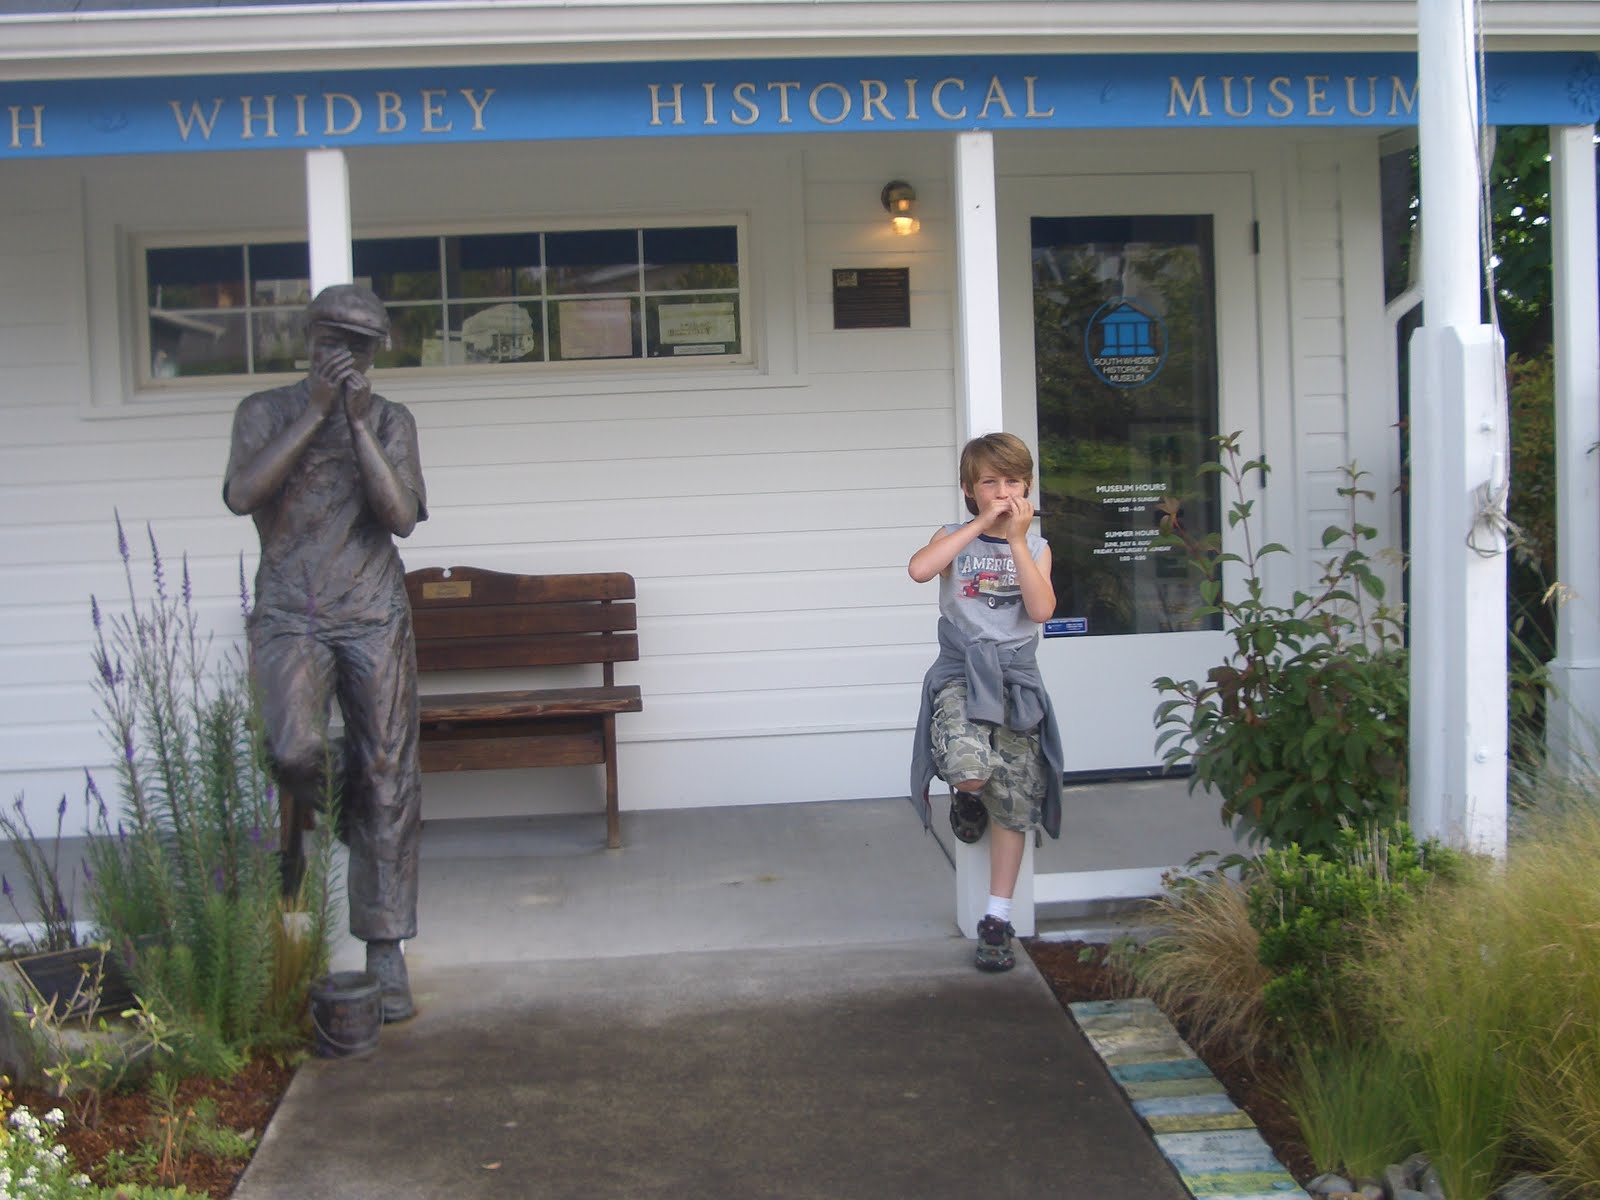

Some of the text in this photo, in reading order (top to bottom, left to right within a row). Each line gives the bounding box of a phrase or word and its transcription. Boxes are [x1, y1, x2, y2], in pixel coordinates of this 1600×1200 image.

[168, 87, 496, 143] WHIDBEY
[647, 74, 1056, 127] HISTORICAL
[1166, 74, 1420, 119] MUSEUM
[1094, 358, 1123, 366] SOUTH
[1103, 366, 1152, 374] HISTORICAL
[1110, 374, 1145, 382] MUSEUM
[1096, 483, 1167, 493] MUSEUM HOURS
